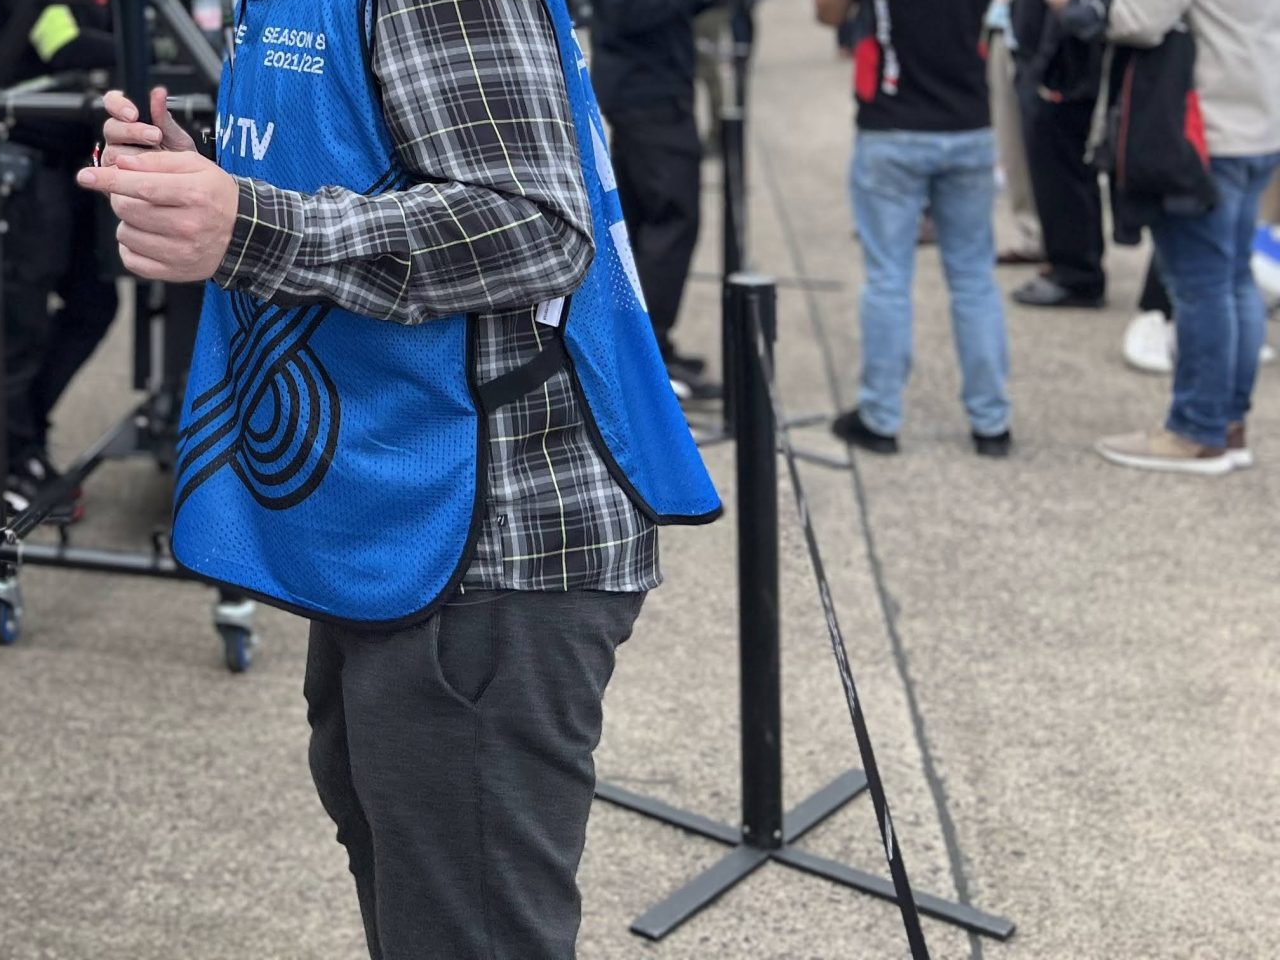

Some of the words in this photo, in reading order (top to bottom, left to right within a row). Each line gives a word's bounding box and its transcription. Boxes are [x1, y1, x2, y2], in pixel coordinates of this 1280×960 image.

[262, 26, 314, 49] SEASON
[315, 33, 326, 50] 8
[263, 49, 325, 75] 2021/22
